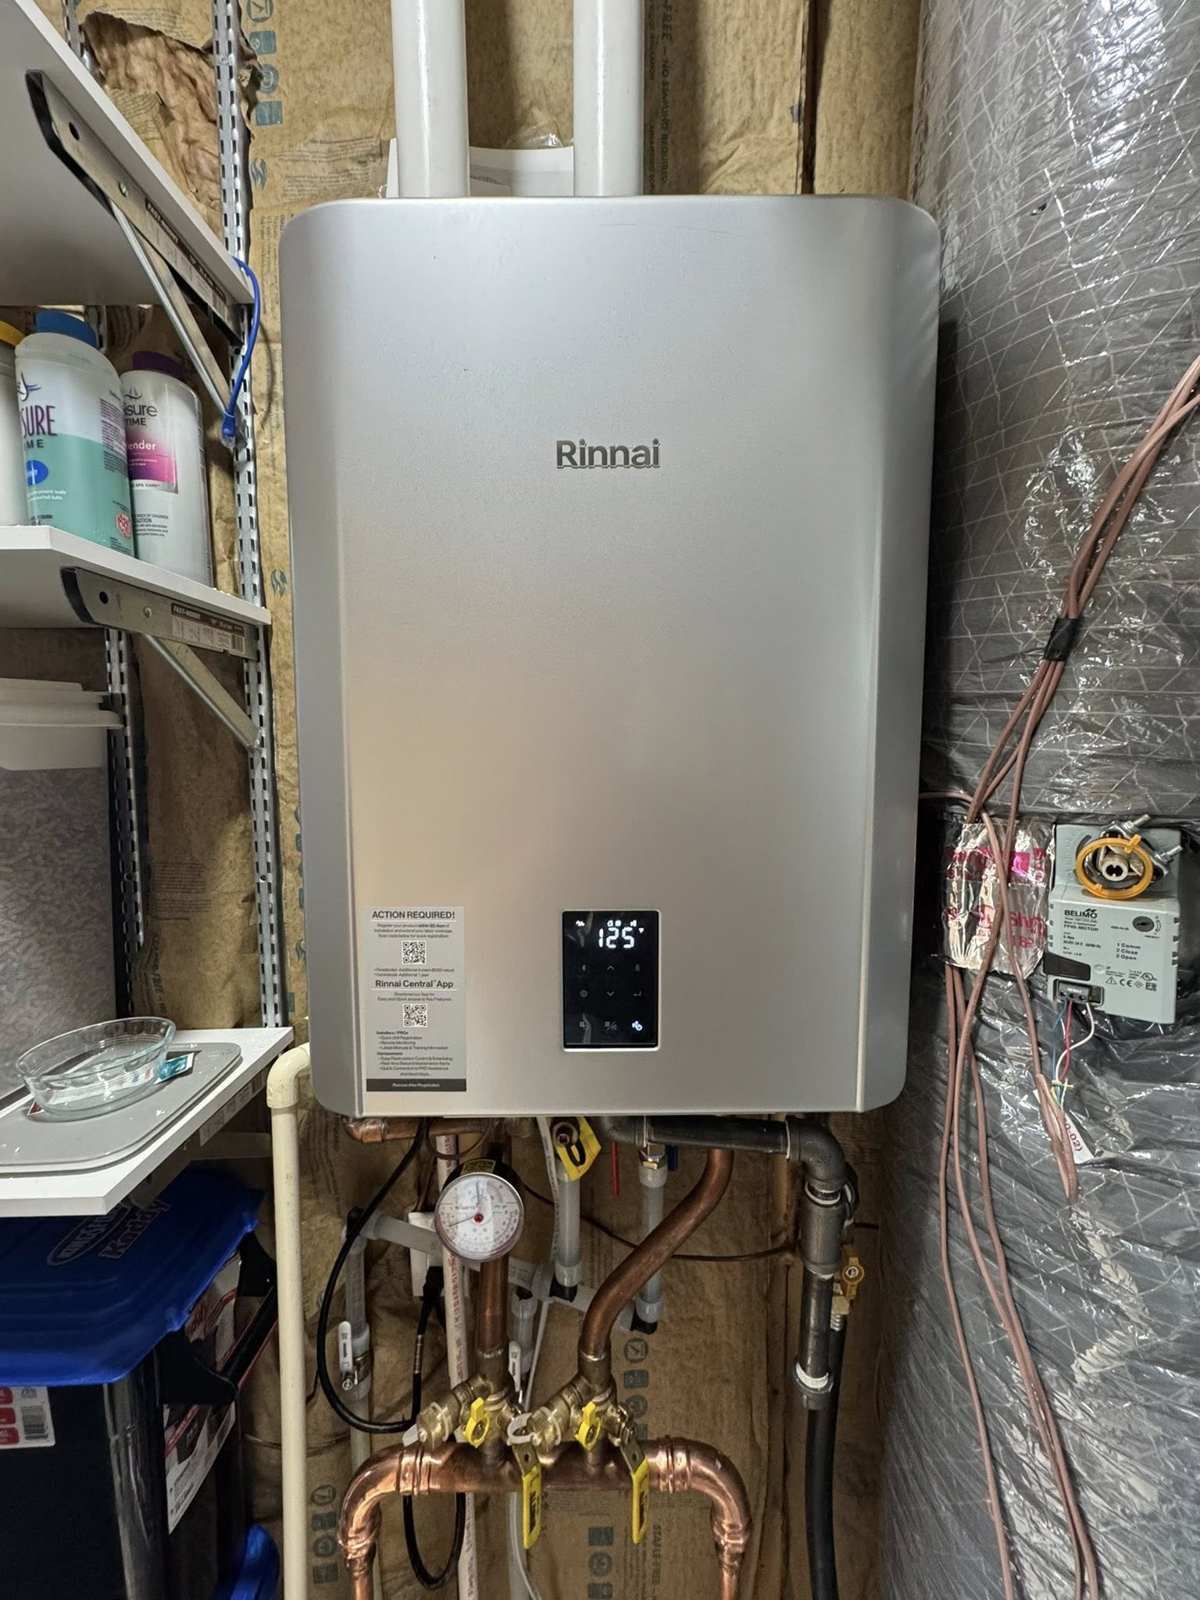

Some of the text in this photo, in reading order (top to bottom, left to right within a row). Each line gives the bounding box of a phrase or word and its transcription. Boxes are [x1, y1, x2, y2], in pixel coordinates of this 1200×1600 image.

[556, 438, 660, 468] Rinnai
[372, 911, 455, 919] ACTION REQUIRED!
[1064, 909, 1098, 919] BELIMO
[599, 927, 635, 948] 125
[375, 980, 401, 988] Rinnai
[436, 980, 454, 989] App
